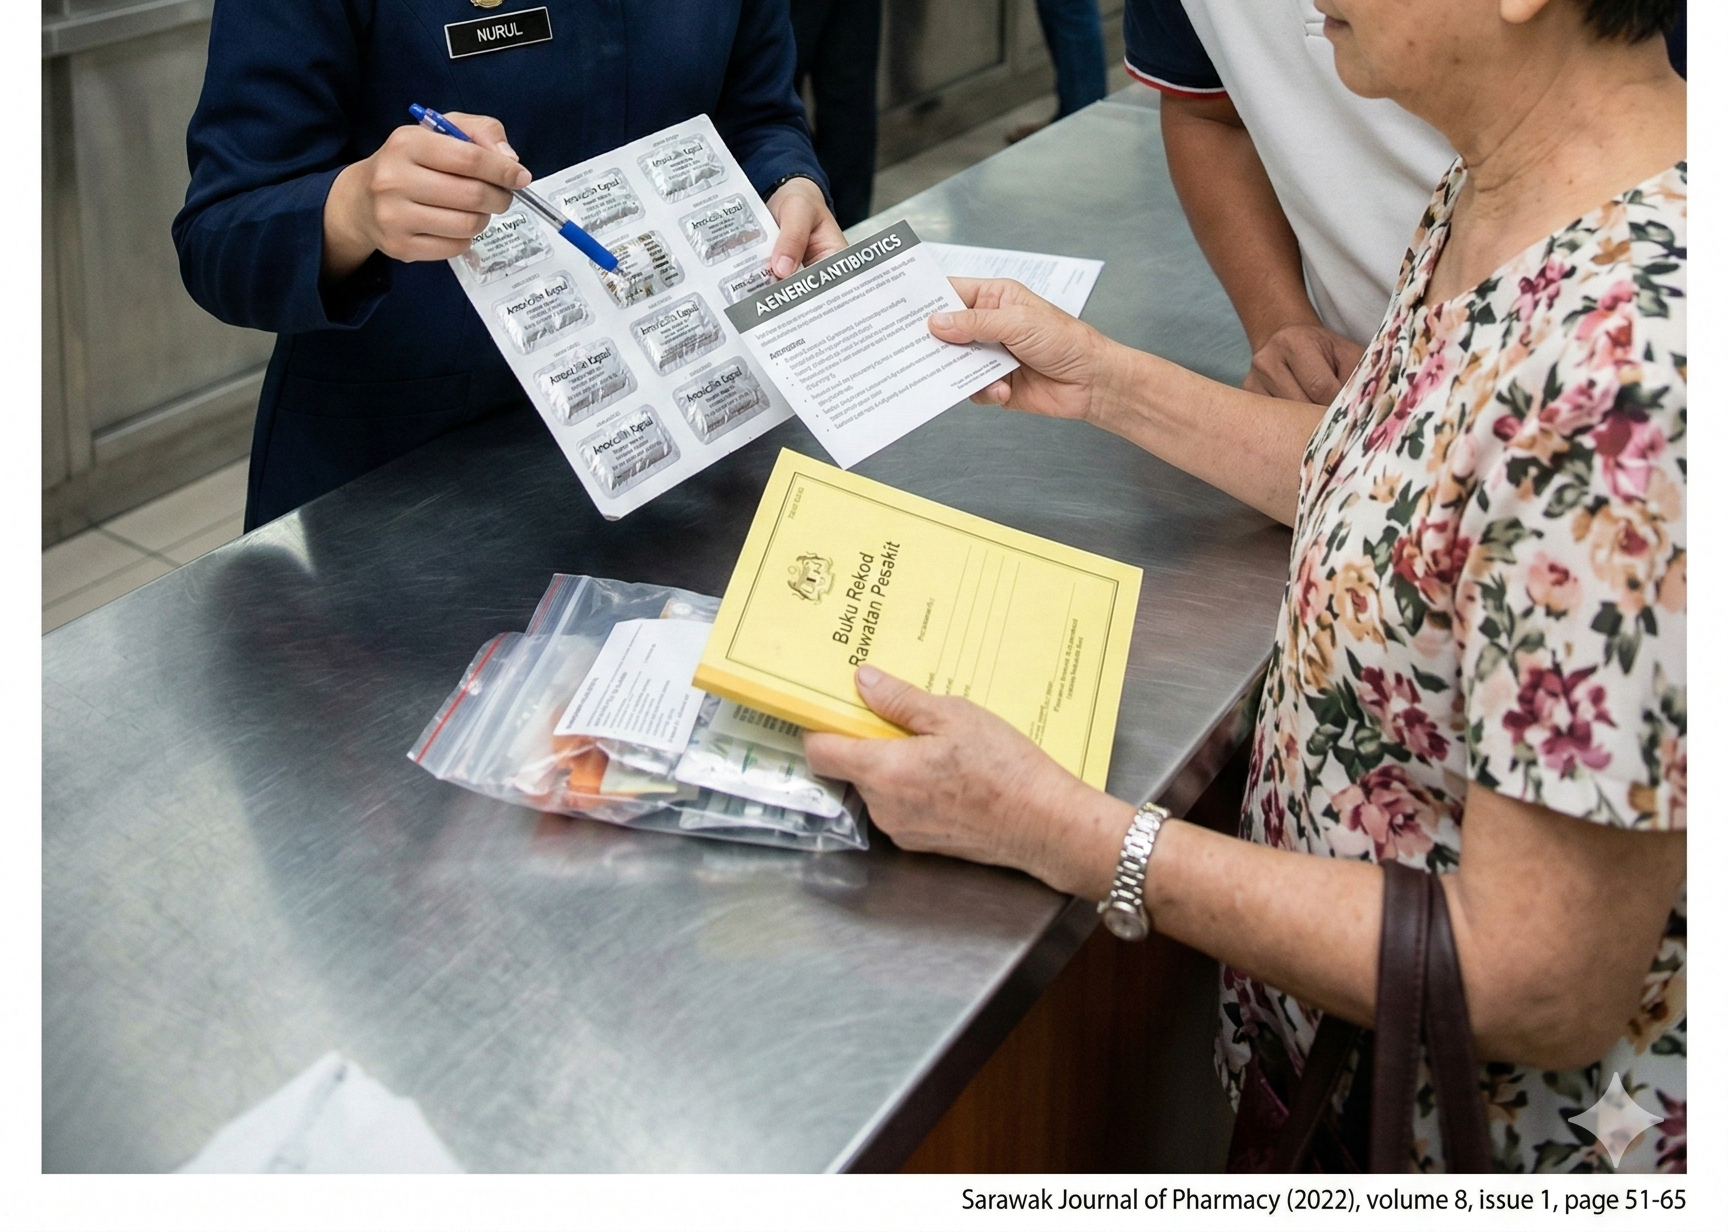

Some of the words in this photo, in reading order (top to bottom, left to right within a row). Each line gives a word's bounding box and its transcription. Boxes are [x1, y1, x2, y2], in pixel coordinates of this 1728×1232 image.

[476, 21, 524, 43] NURUL
[817, 233, 903, 288] ANTIBIOTICS
[845, 551, 875, 602] Rekod
[832, 603, 859, 645] Buku
[848, 600, 883, 667] Rawatan
[870, 540, 901, 598] Pesakit
